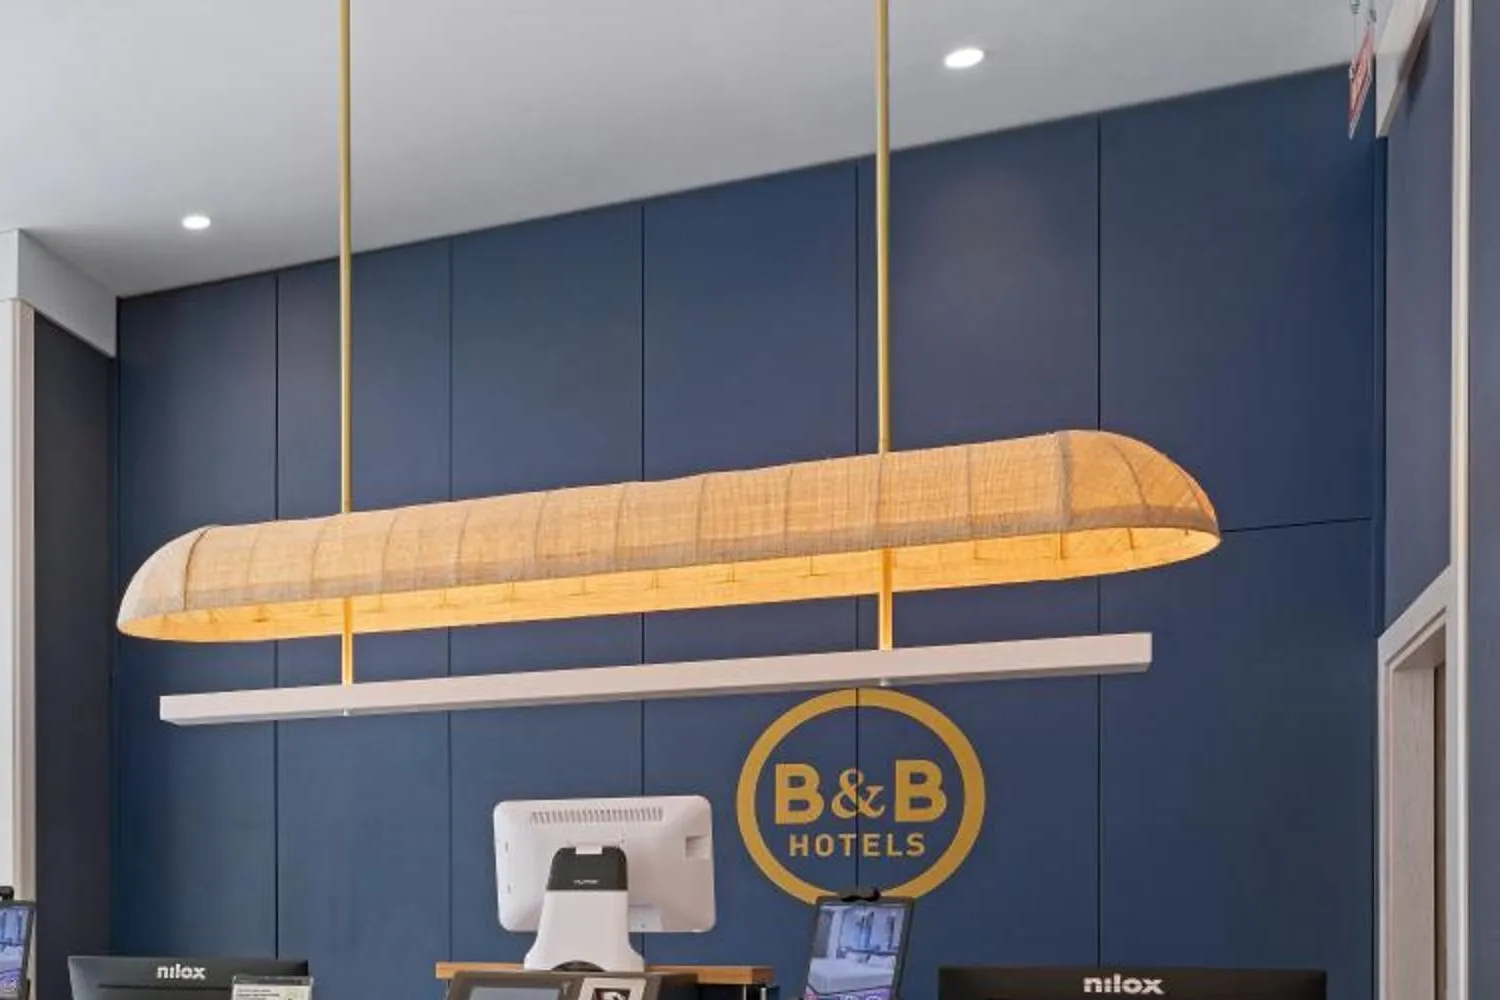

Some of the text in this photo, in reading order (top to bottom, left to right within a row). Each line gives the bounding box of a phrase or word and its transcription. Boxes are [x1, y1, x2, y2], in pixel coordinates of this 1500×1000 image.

[775, 760, 947, 824] B&B
[789, 832, 926, 857] HOTELS
[157, 963, 206, 980] nilox
[1083, 973, 1165, 995] nilox
